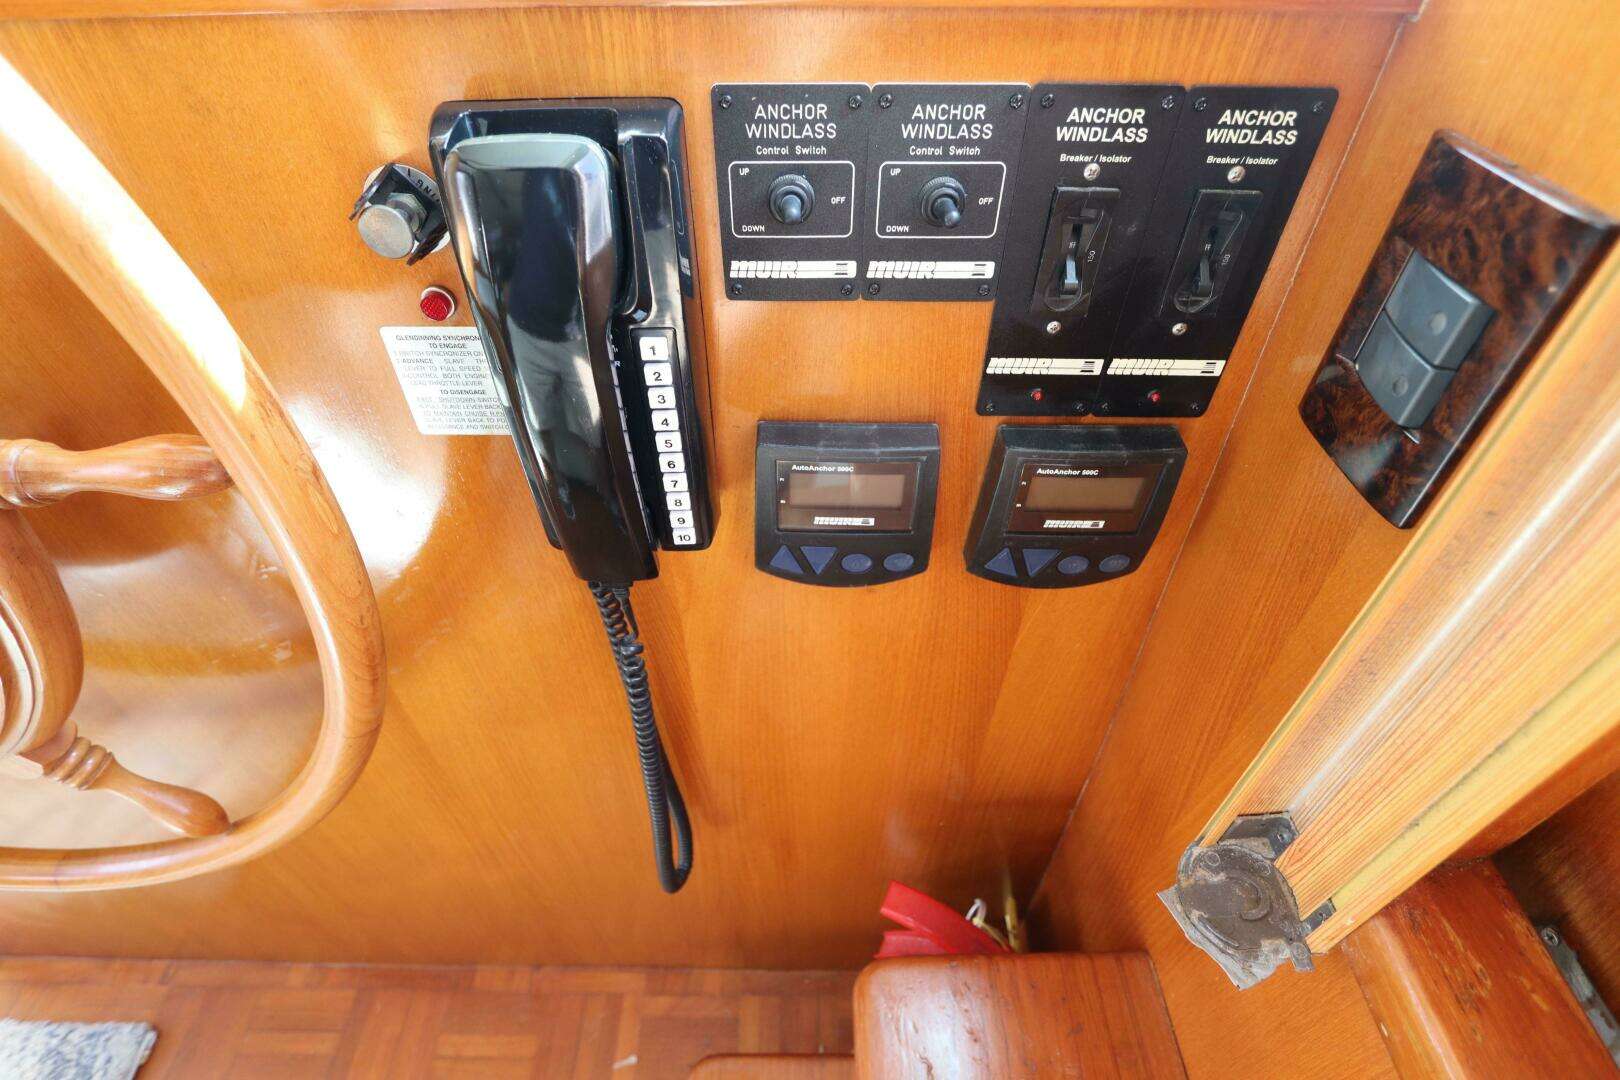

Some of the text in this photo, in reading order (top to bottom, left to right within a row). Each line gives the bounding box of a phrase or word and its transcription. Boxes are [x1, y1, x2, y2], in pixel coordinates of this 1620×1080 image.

[754, 103, 828, 120] ANCHOR
[911, 103, 986, 120] ANCHOR
[1066, 107, 1145, 124] ANCHOR
[1217, 109, 1298, 127] ANCHOR
[745, 123, 837, 139] WINDLASS
[901, 123, 993, 140] WINDLASS
[1055, 126, 1148, 143] WINDLASS
[1205, 128, 1298, 145] WINDLASS
[755, 145, 827, 156] Control Switch
[909, 145, 981, 156] Control Switch
[1059, 154, 1094, 163] Breaker
[1099, 154, 1132, 164] Isolator
[1206, 155, 1240, 165] Breaker
[1246, 156, 1278, 166] Isolator
[739, 168, 749, 176] UP
[890, 168, 901, 176] UP
[830, 196, 846, 205] OFF
[978, 197, 994, 205] OFF
[742, 225, 765, 233] DOWN
[886, 225, 909, 233] DOWN
[729, 260, 801, 279] MUIR
[866, 261, 937, 279] MUIR
[649, 345, 656, 356] 1
[653, 371, 662, 382] 2
[657, 395, 666, 404] 3
[661, 417, 670, 427] 4
[664, 439, 673, 448] 5
[667, 460, 676, 469] 6
[792, 464, 836, 473] AutoAnchor
[1036, 468, 1081, 476] AutoAnchor
[670, 480, 678, 488] 7
[674, 498, 682, 507] 8
[677, 517, 685, 525] 9
[677, 534, 691, 542] 10
